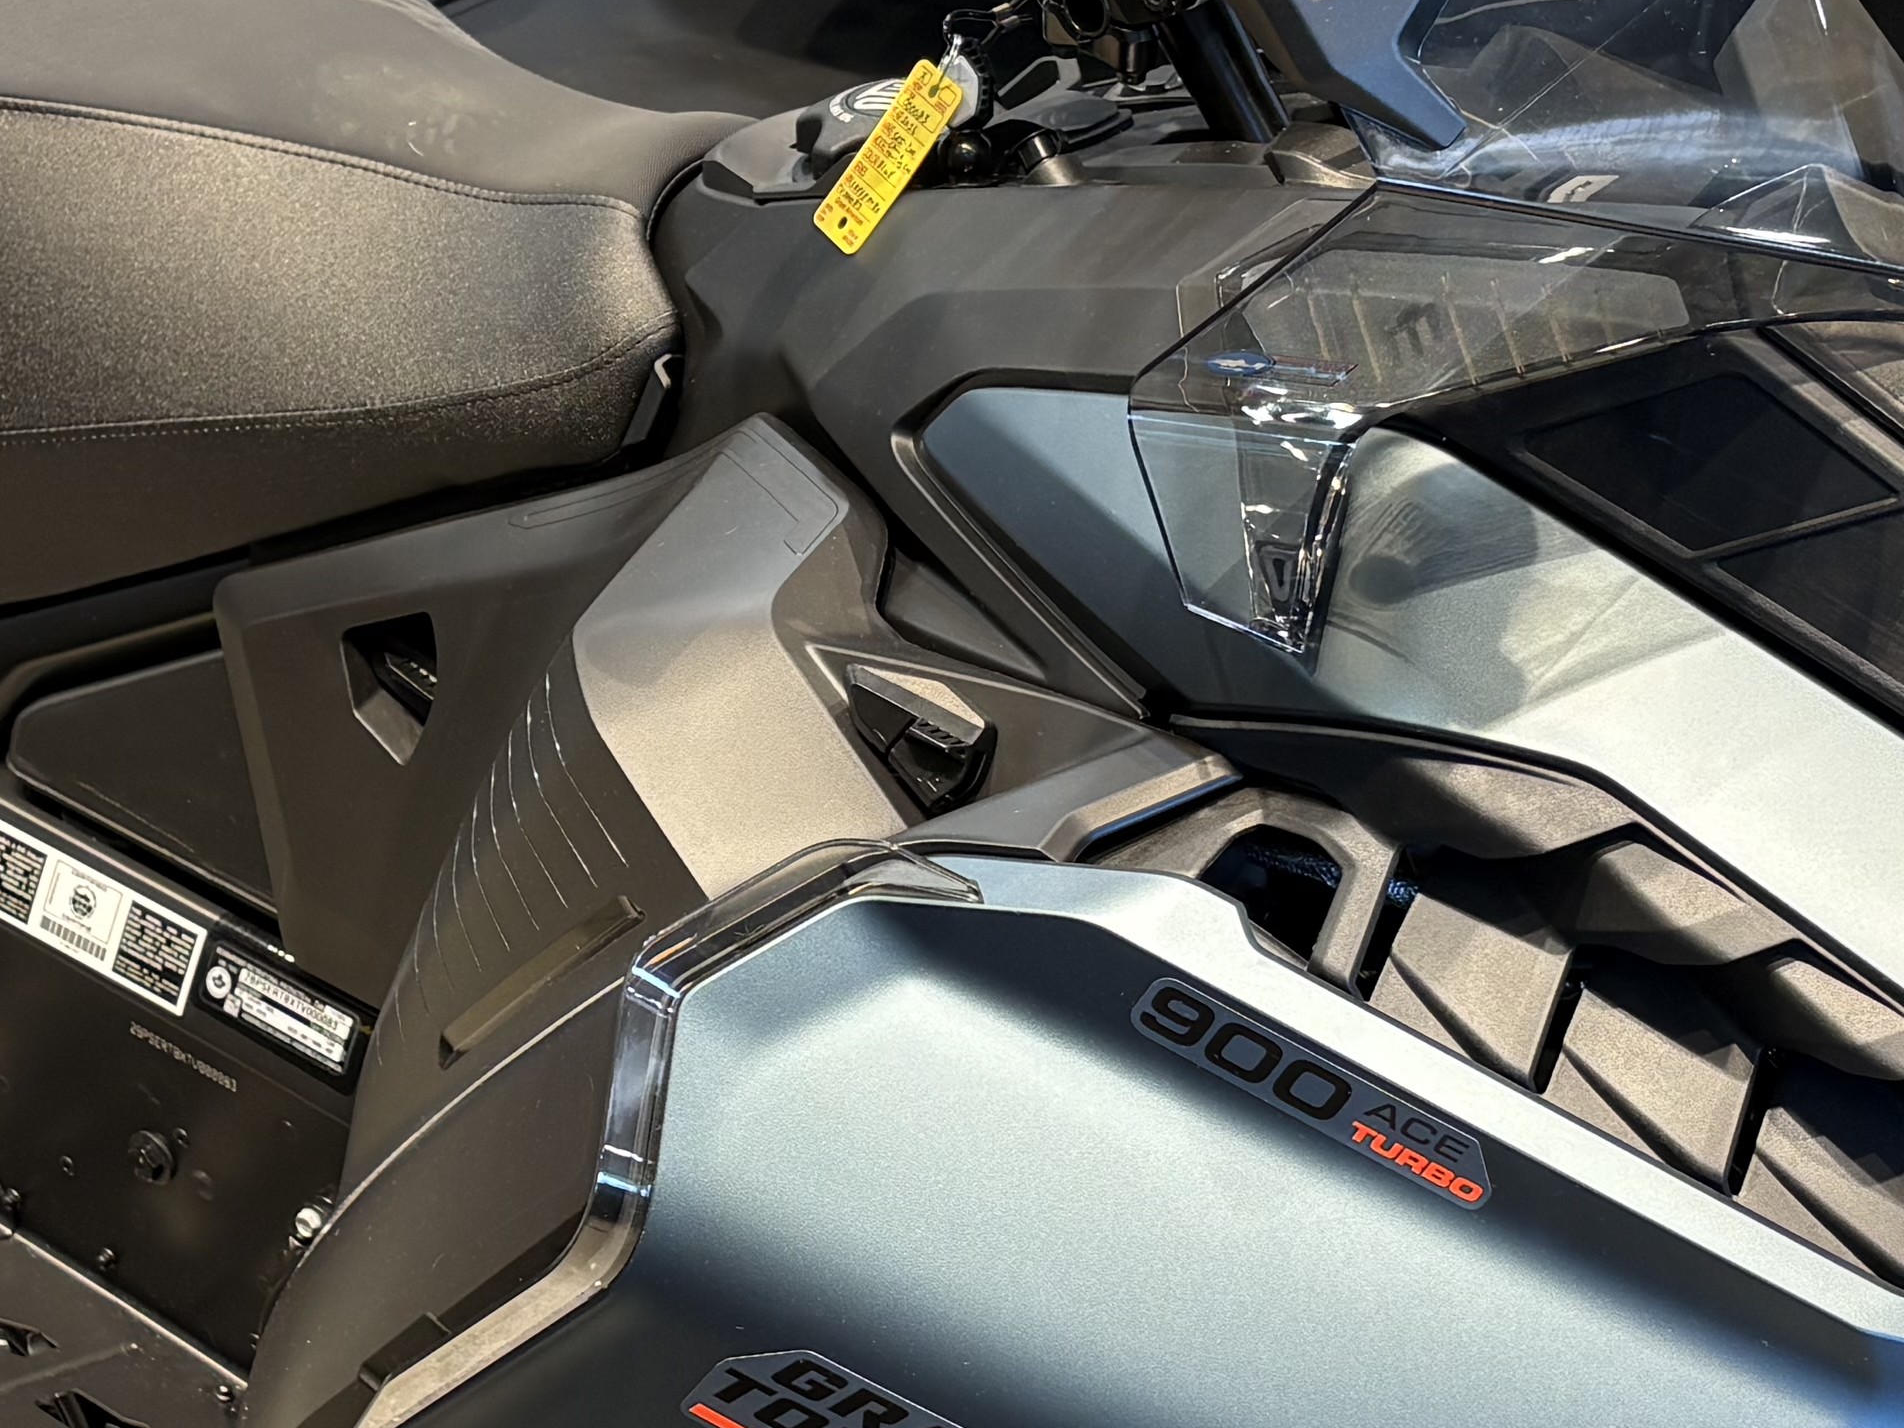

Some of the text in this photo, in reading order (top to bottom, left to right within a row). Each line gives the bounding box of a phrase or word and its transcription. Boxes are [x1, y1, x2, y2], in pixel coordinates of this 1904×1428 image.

[1138, 985, 1471, 1164] 900 ACE
[1350, 1120, 1485, 1204] TURBO
